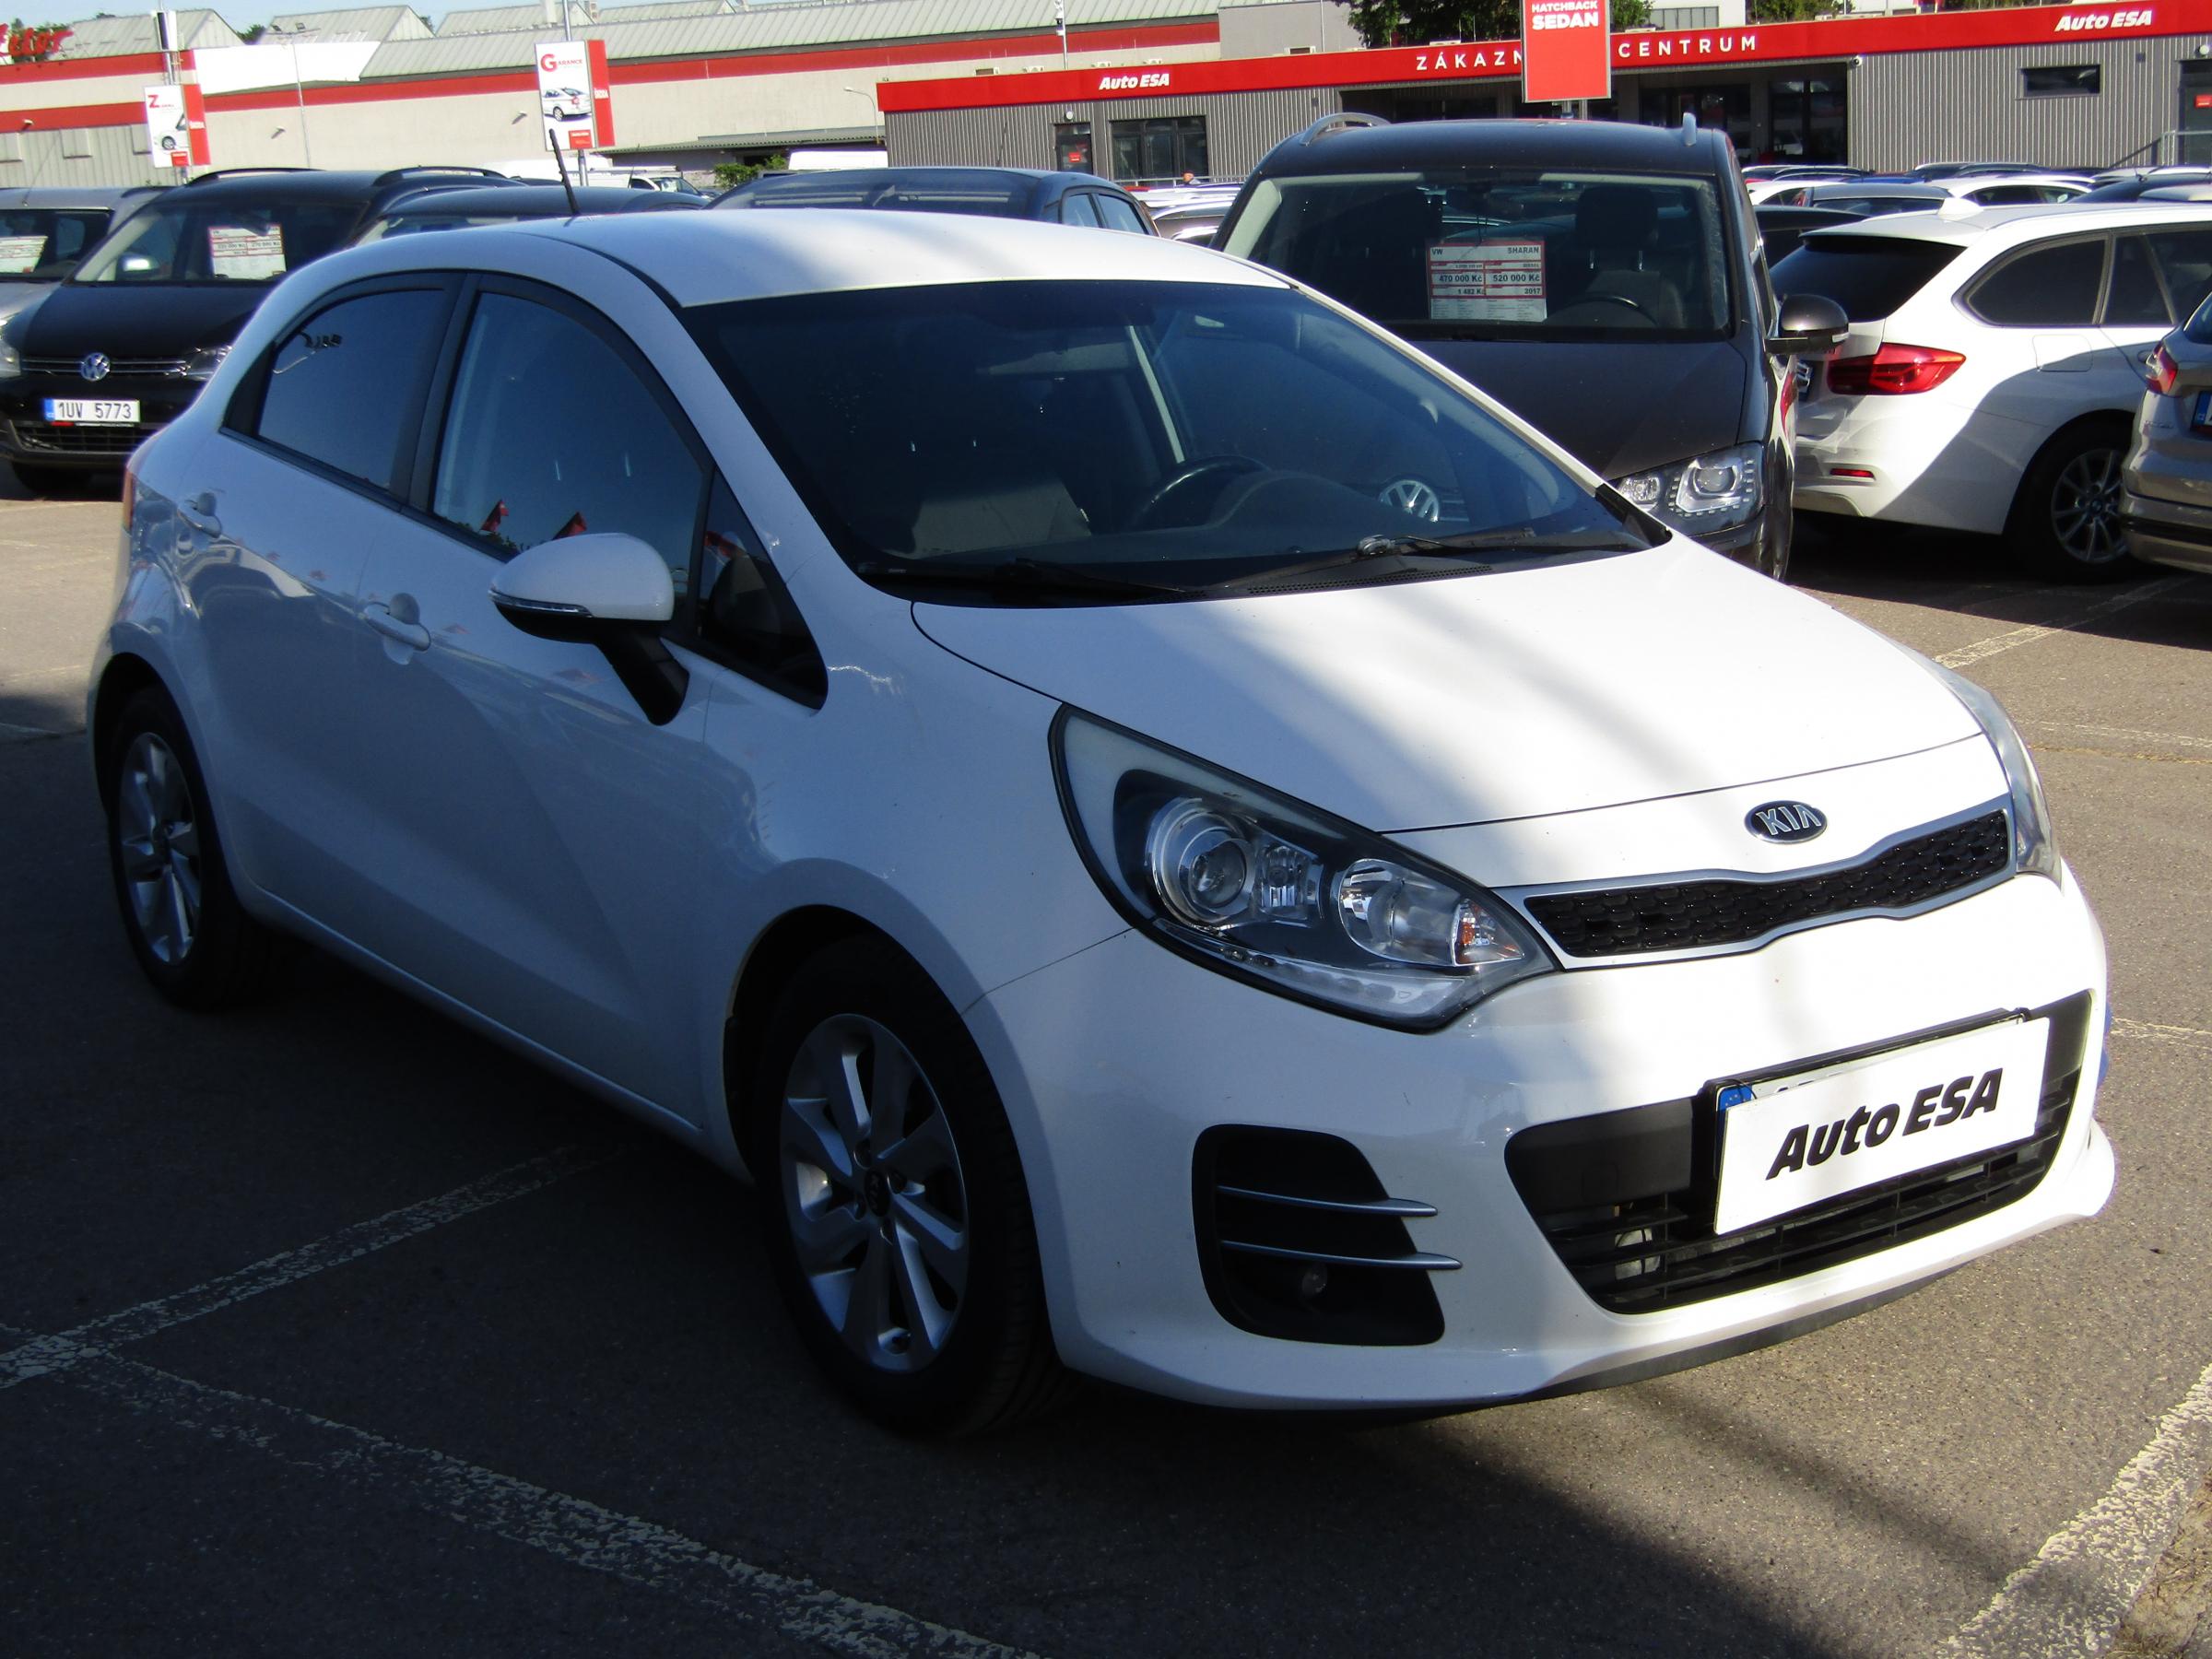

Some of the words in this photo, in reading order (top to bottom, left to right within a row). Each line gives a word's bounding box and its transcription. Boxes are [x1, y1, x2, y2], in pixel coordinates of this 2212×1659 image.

[1531, 0, 1598, 13] HATCHBACK
[1532, 11, 1599, 30] SEDAN
[2053, 13, 2110, 32] Auto
[2111, 9, 2153, 29] ESA
[1415, 49, 1523, 72] ZÁKAZN
[1618, 35, 1757, 59] CENTRUM
[1098, 76, 1139, 90] Auto
[1139, 73, 1170, 88] ESA
[1507, 246, 1539, 254] SHARAN
[1439, 275, 1453, 283] 470
[1454, 274, 1470, 282] 000
[1472, 274, 1483, 282] Kč
[1493, 274, 1508, 282] 520
[1510, 274, 1526, 282] 000
[1528, 273, 1540, 282] Kč
[58, 401, 84, 418] 1UV
[94, 402, 132, 419] 5773
[1755, 804, 1822, 836] KIA
[1765, 1102, 1901, 1181] Auto
[1901, 1067, 2004, 1136] ESA
